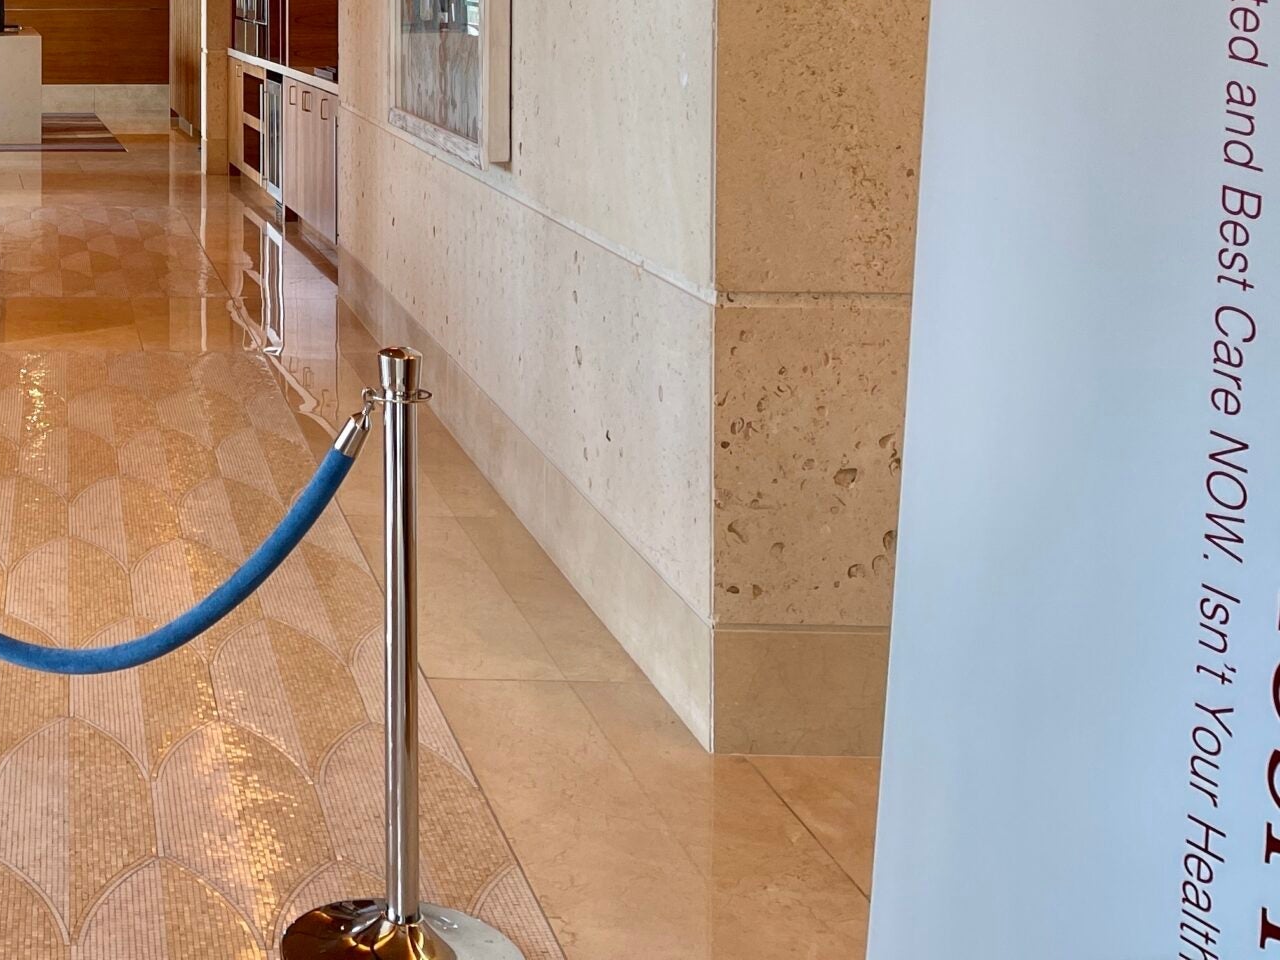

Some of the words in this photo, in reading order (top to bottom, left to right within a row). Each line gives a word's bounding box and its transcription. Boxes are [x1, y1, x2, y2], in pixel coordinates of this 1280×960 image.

[1225, 81, 1263, 173] and
[1217, 184, 1262, 292] Best
[1211, 305, 1256, 416] Care
[1203, 429, 1249, 564] NOW.
[1195, 582, 1240, 686] Isn't
[1190, 702, 1234, 809] Your
